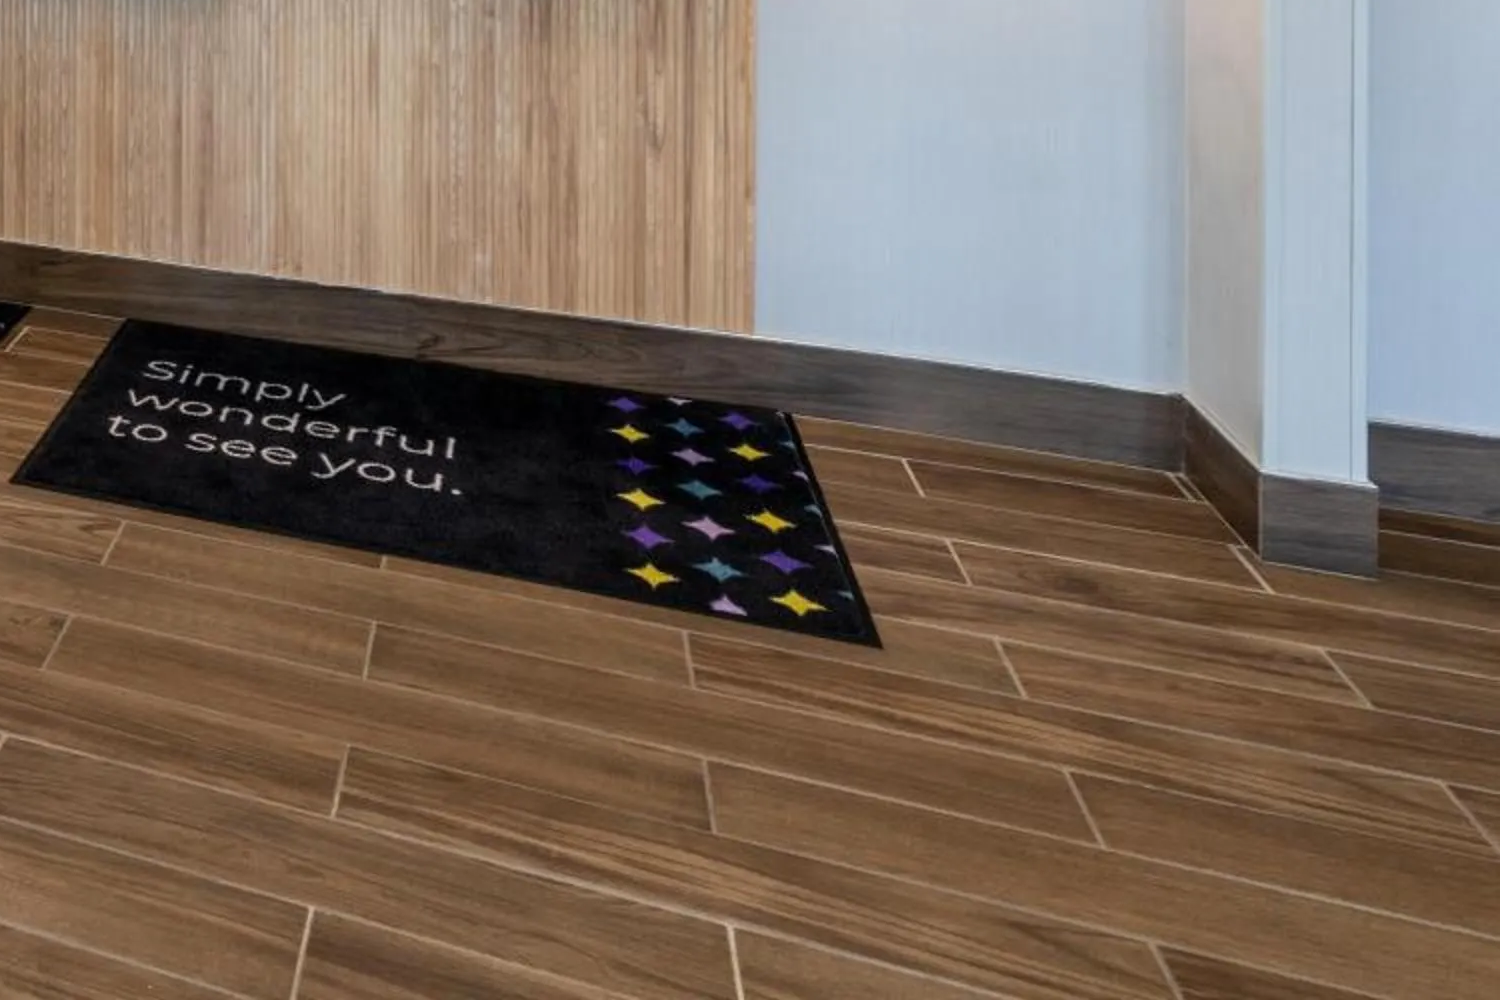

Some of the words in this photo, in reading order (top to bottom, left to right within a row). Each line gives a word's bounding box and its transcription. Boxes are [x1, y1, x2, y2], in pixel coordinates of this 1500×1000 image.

[142, 359, 348, 410] Simply
[107, 413, 169, 443] to
[184, 432, 299, 467] see
[311, 452, 464, 497] you.
[126, 387, 458, 460] wonderful
